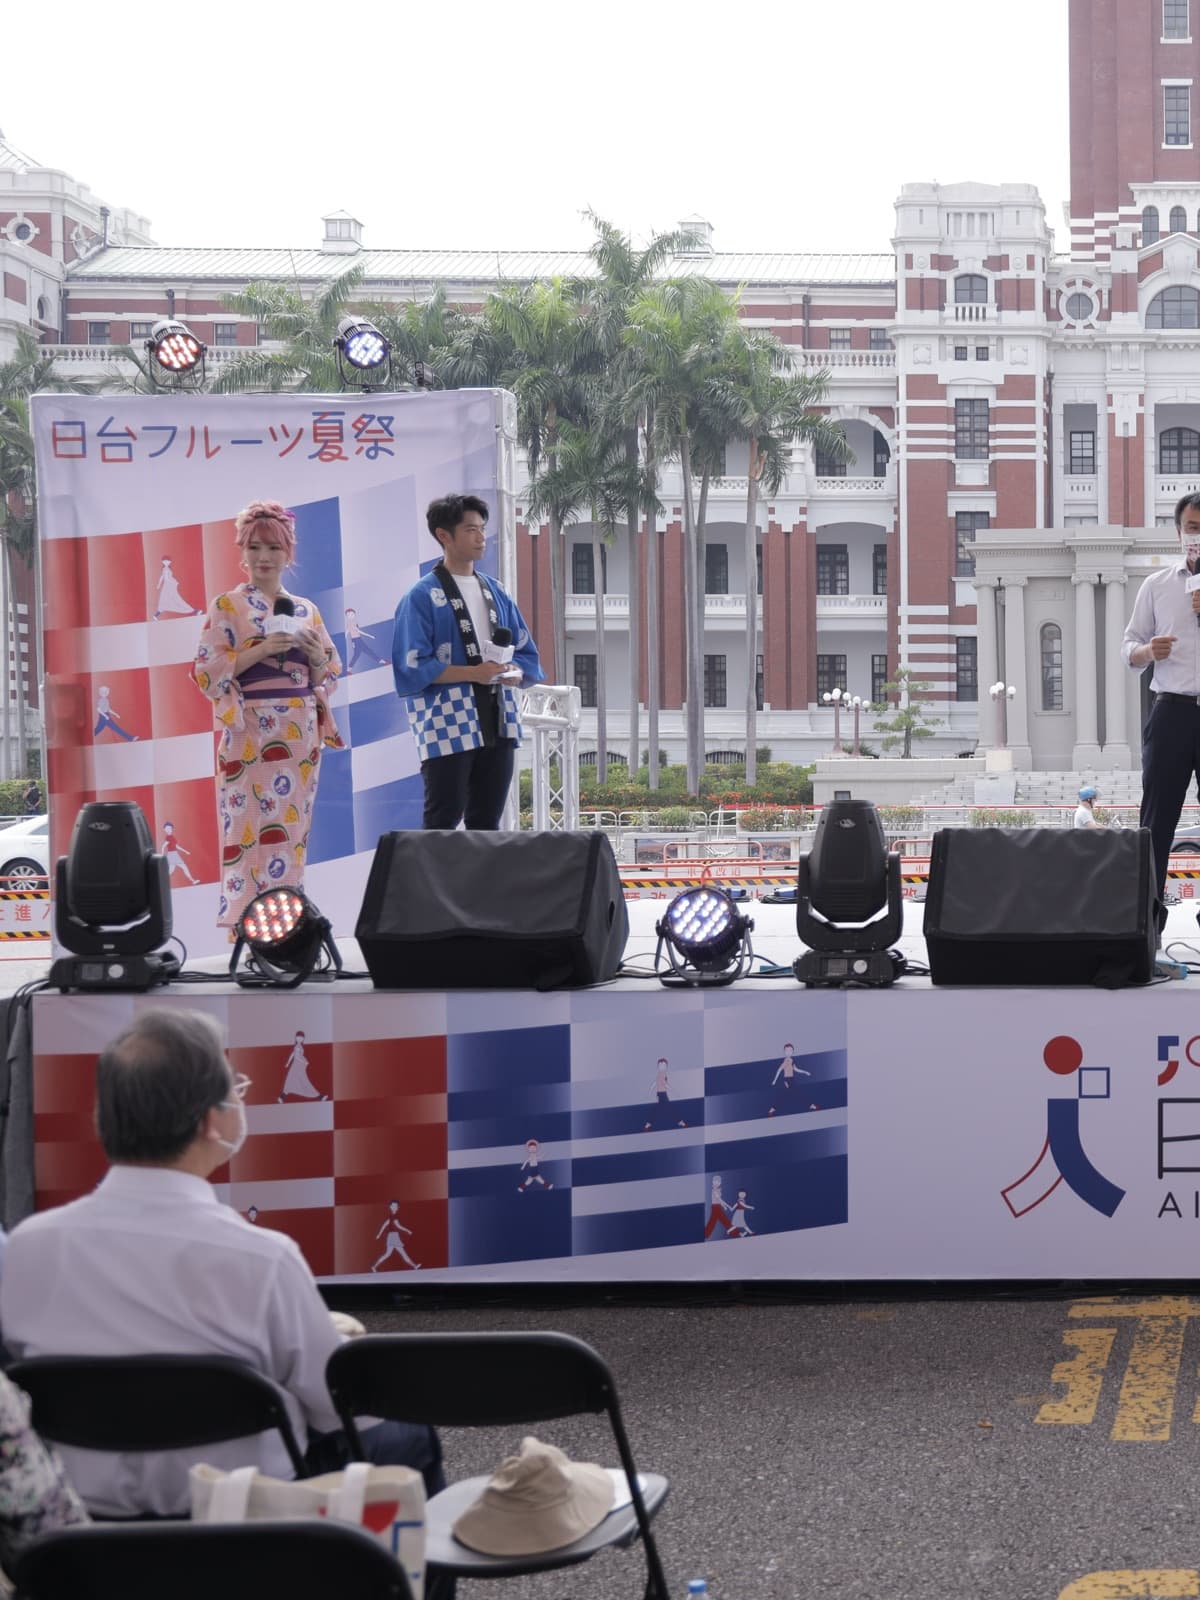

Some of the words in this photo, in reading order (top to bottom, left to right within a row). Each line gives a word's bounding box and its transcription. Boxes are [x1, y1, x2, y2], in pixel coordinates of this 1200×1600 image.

[51, 411, 396, 463] 日台フルーツ夏祭
